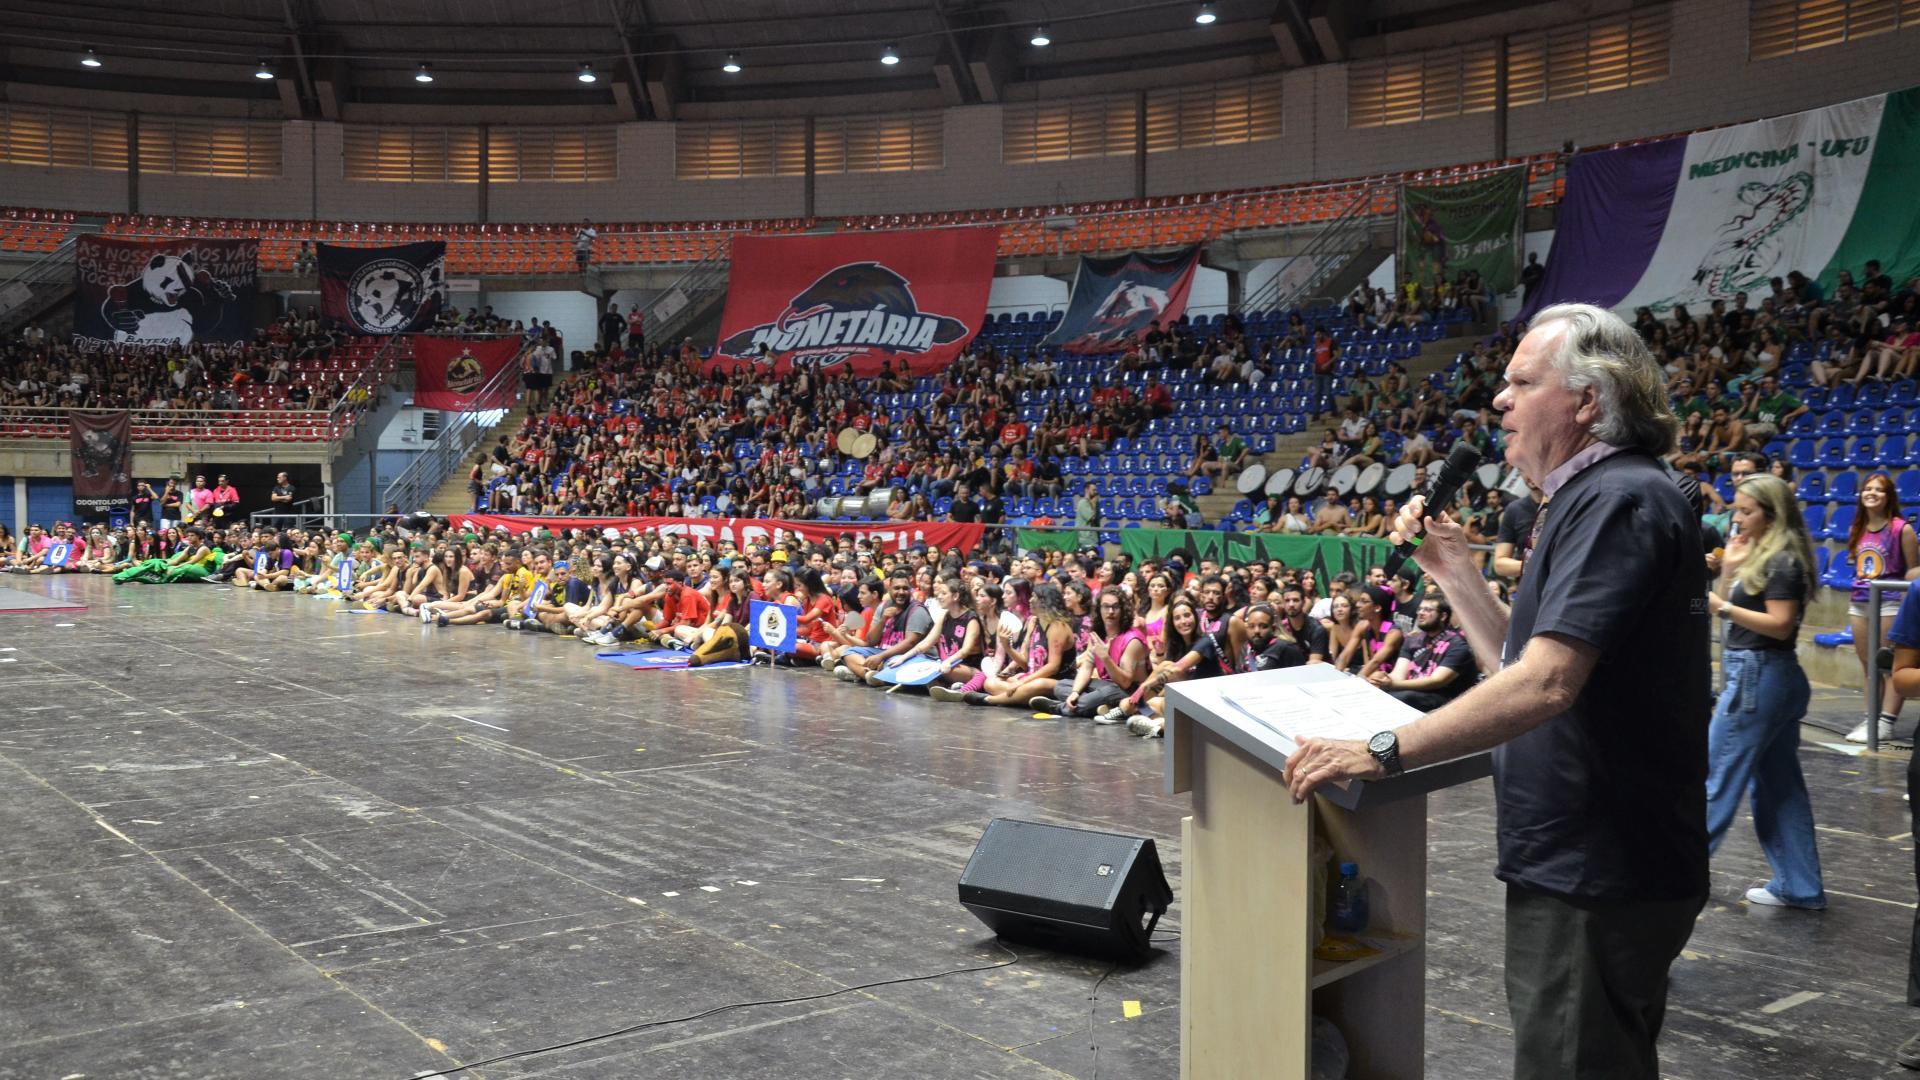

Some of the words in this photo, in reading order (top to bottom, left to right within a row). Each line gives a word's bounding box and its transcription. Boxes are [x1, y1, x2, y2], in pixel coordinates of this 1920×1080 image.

[1689, 143, 1799, 180] MEDICINA
[1819, 135, 1870, 158] UFU
[79, 241, 101, 258] AS
[213, 260, 255, 277] TANTO
[746, 304, 939, 353] MONETÁRIA
[125, 335, 180, 345] BATERIA
[76, 498, 128, 506] ODONTOLOGIA
